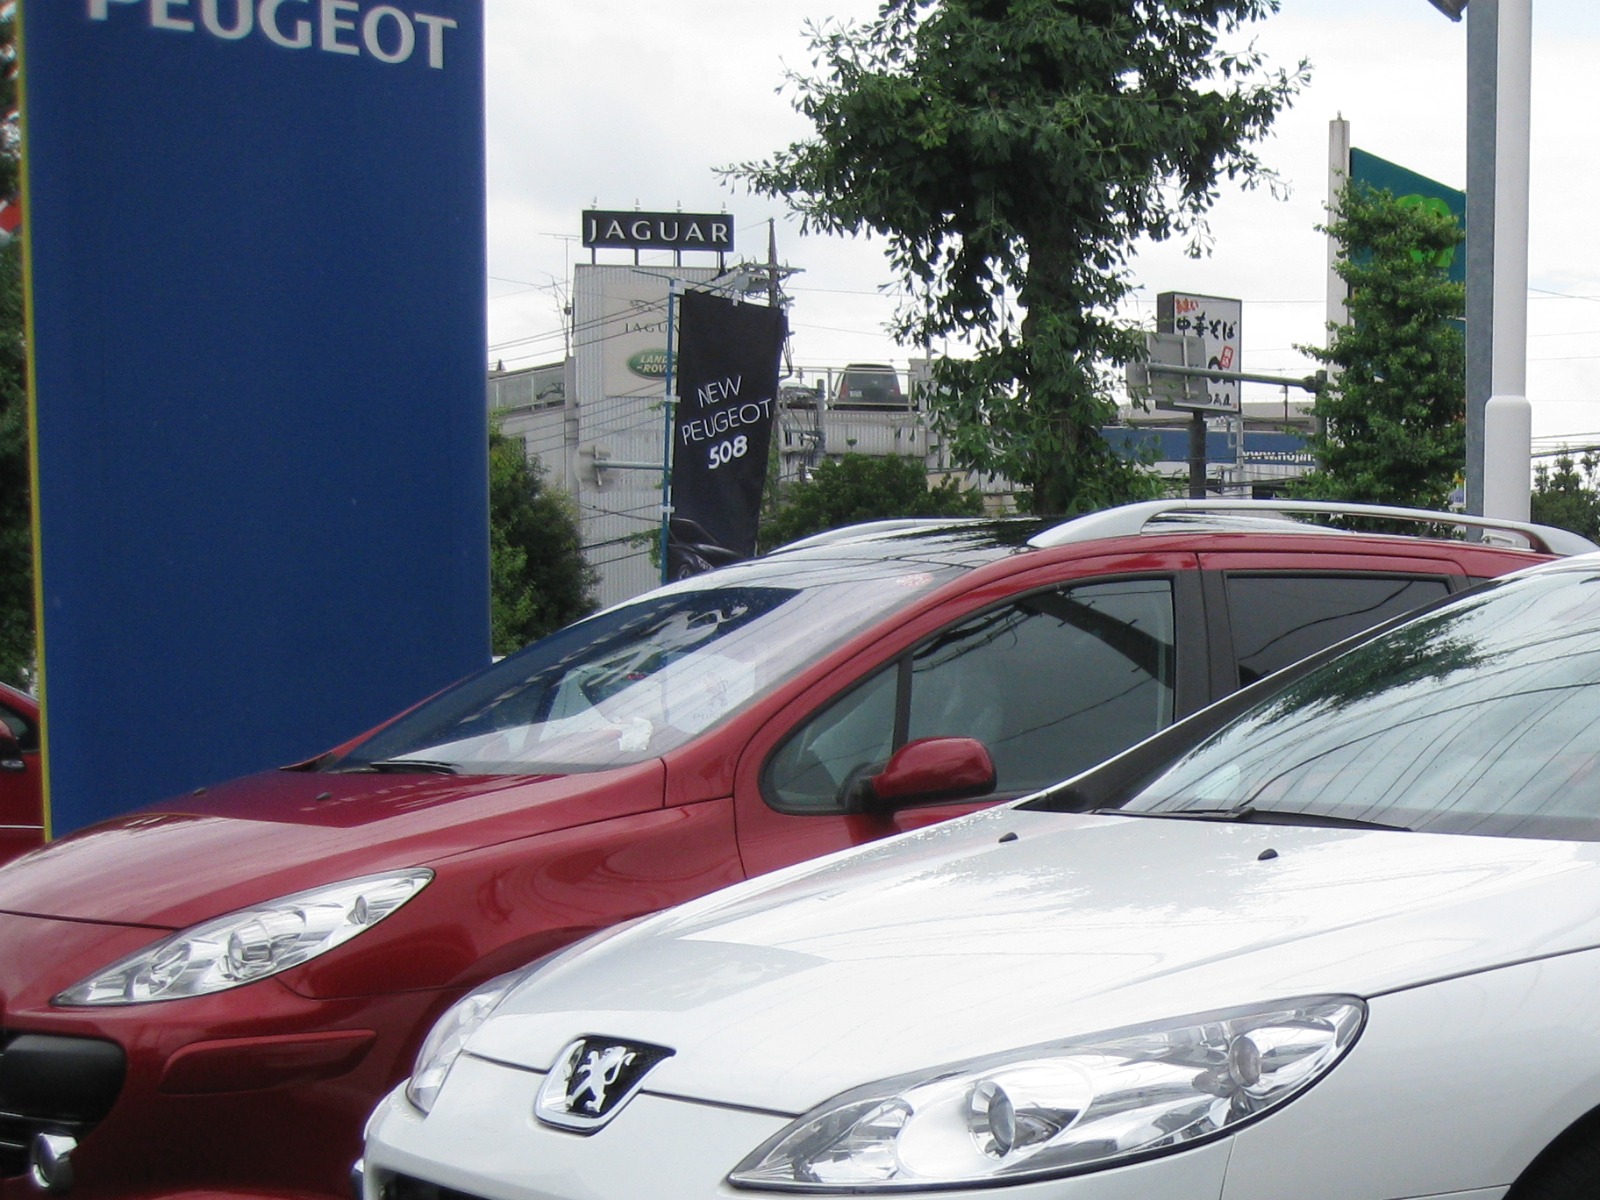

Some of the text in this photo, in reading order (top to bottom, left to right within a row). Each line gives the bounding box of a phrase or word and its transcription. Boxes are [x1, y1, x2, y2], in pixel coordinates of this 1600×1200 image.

[588, 219, 729, 243] JAGUAR
[697, 375, 742, 409] NEW
[681, 398, 773, 446] PEUGEOT
[708, 435, 749, 470] 508
